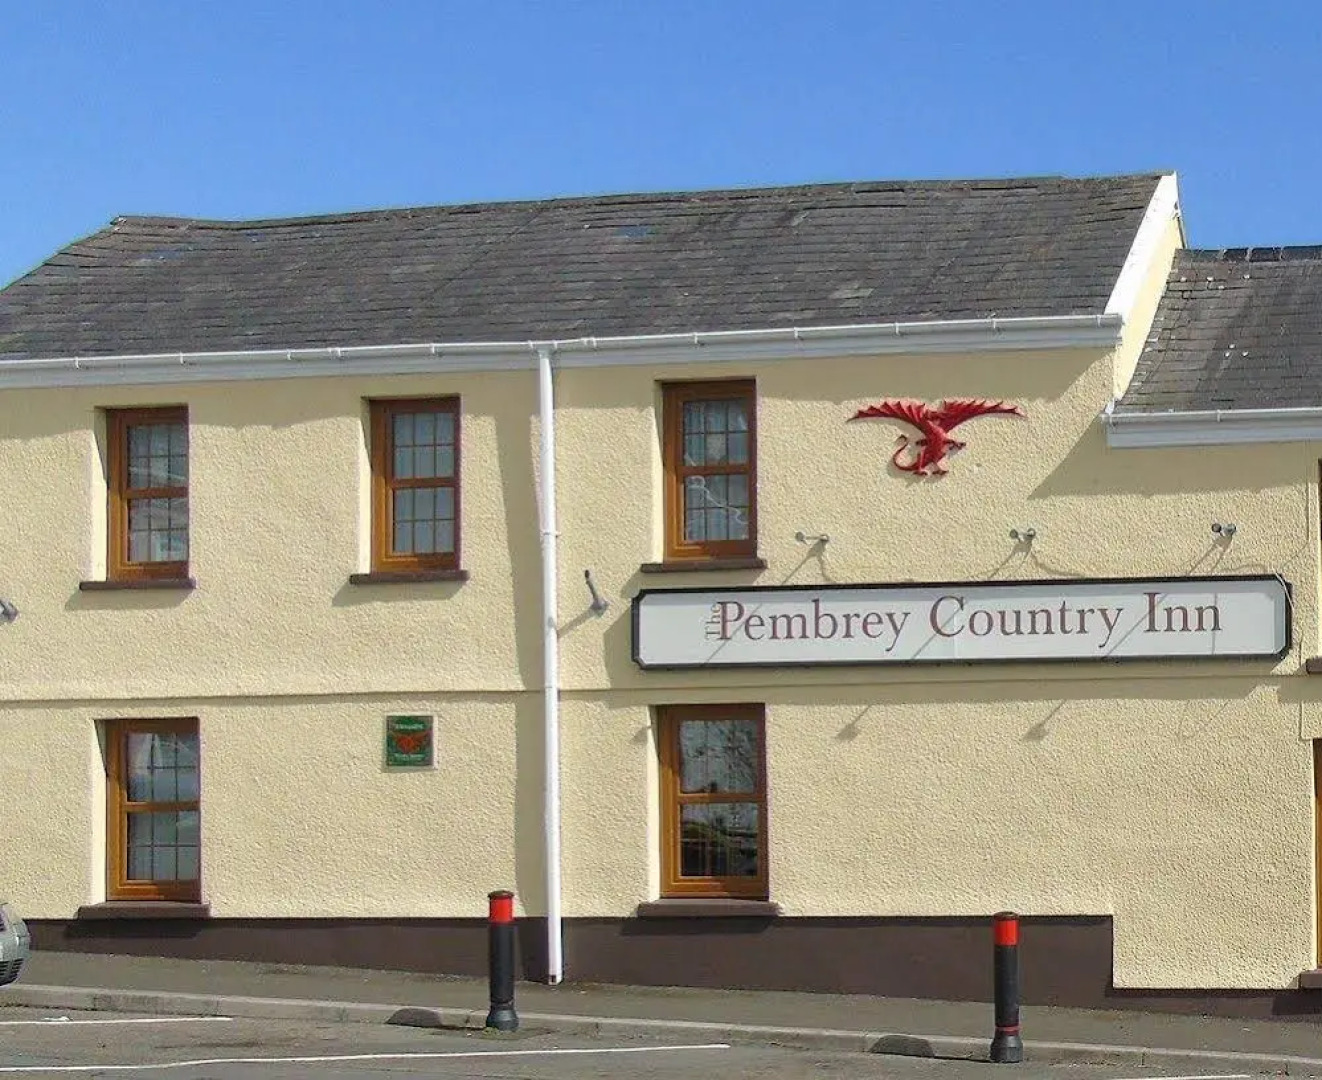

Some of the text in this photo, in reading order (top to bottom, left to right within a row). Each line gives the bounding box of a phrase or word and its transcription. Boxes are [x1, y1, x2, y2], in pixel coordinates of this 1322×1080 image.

[704, 591, 1223, 652] The Pembrey Country Inn
